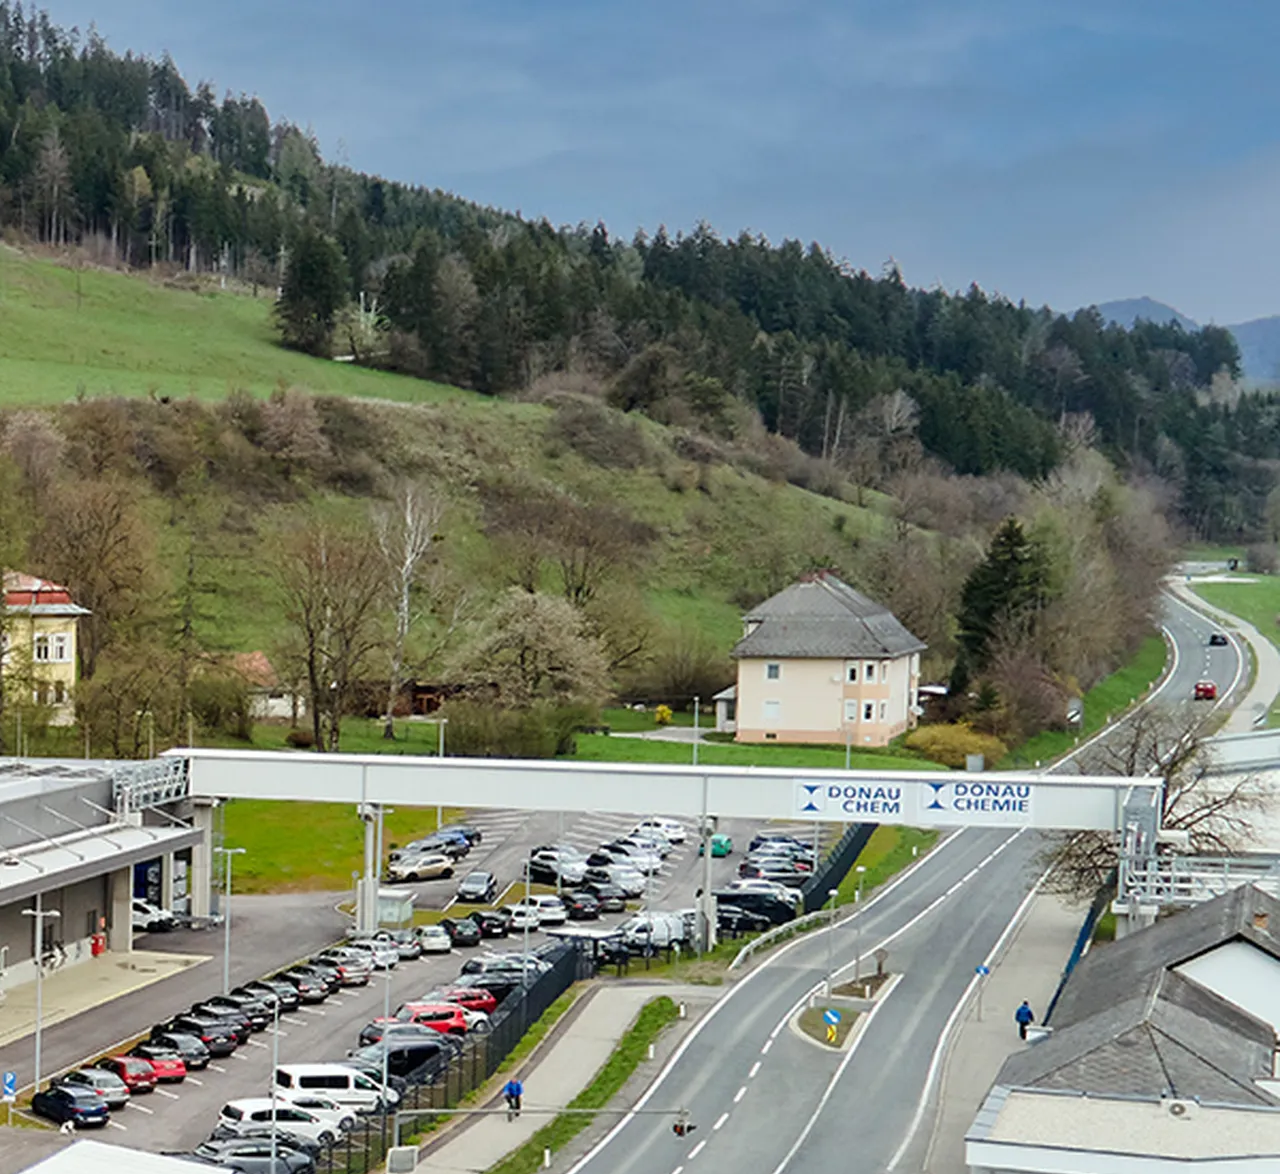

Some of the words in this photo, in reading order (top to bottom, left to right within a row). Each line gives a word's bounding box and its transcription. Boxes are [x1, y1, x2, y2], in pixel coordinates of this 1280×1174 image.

[828, 786, 901, 800] DONAU
[954, 783, 1030, 798] DONAU
[842, 800, 900, 814] CHEM
[953, 798, 1029, 812] CHEMIE
